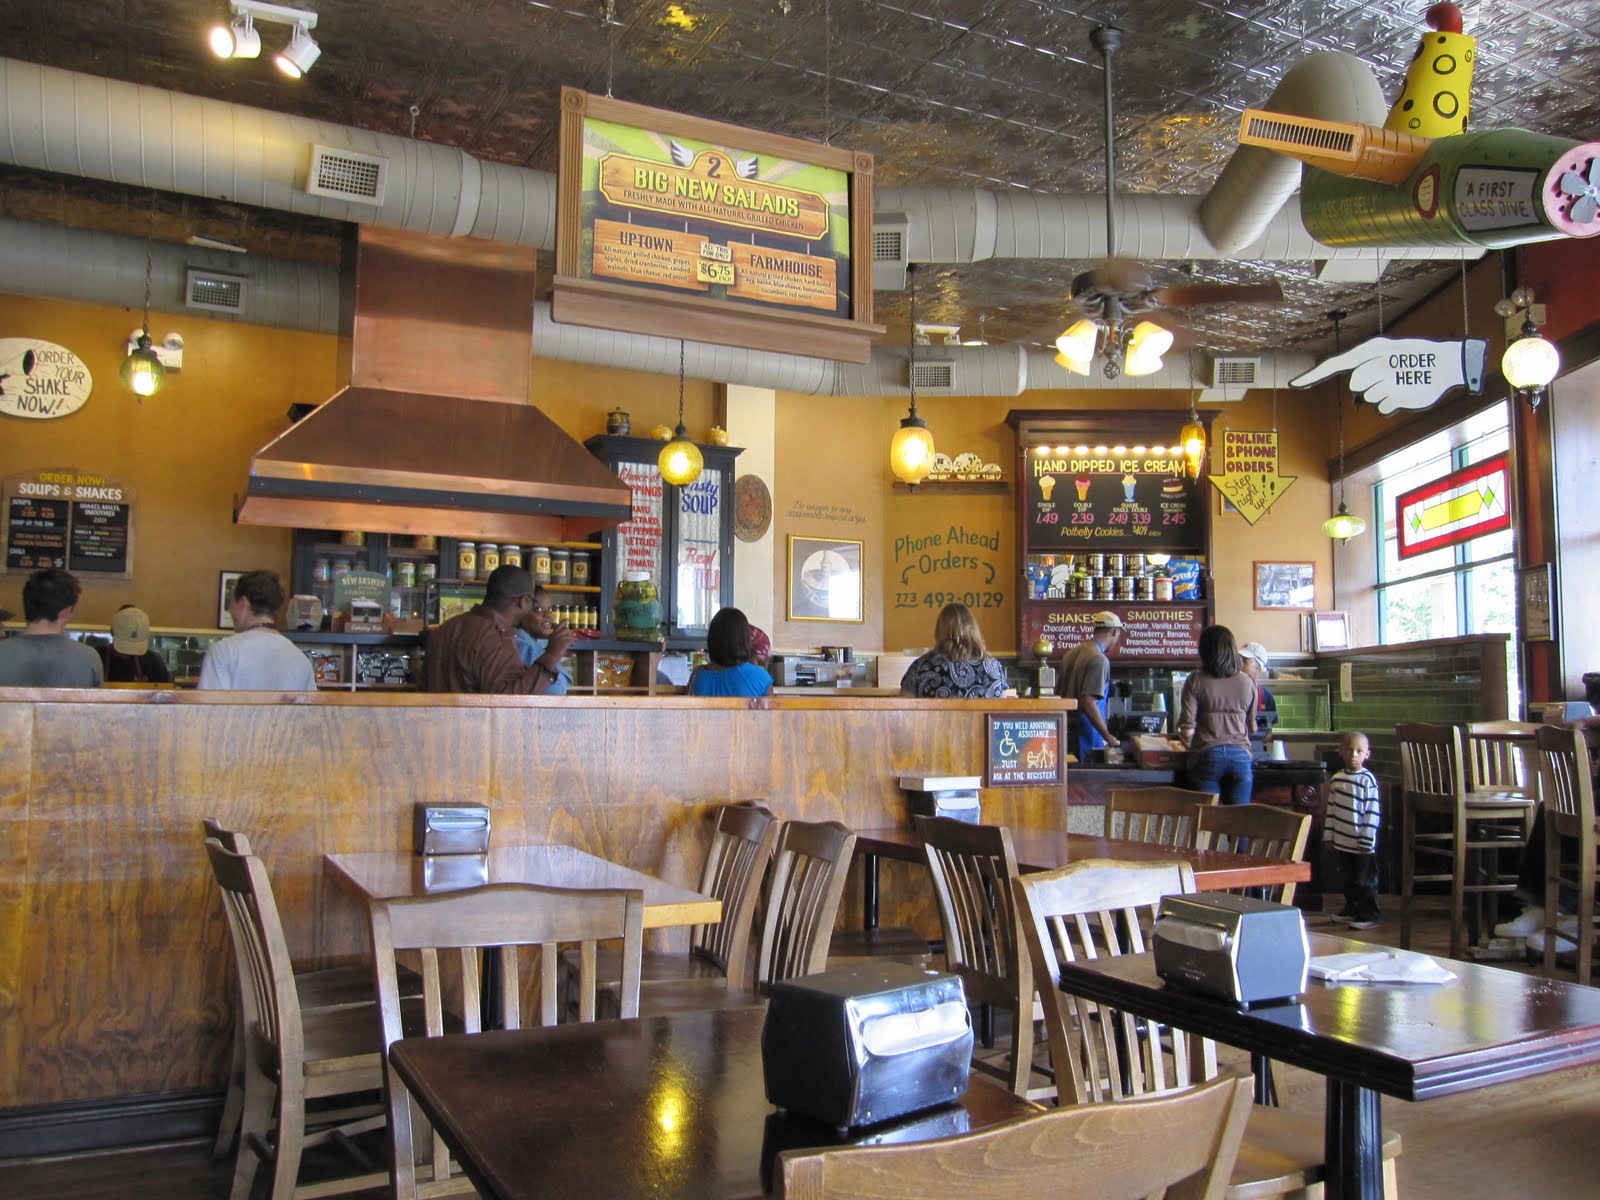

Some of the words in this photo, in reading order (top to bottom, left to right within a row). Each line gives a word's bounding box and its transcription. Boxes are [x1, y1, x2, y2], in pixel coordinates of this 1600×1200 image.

[708, 157, 721, 179] 2
[633, 167, 669, 193] BIG
[674, 175, 719, 203] NEW
[722, 185, 800, 218] SALADS
[1466, 182, 1475, 197] A
[1479, 181, 1515, 198] FIRST
[624, 190, 654, 203] FRESHLY
[655, 197, 677, 208] MADE
[678, 200, 700, 211] WITH
[746, 211, 774, 225] GRILLED
[775, 217, 804, 230] CHICKEN
[1459, 200, 1496, 218] CLASS
[1499, 200, 1529, 217] DIVE
[620, 231, 673, 253] UPTOWN
[704, 243, 714, 251] ALL
[716, 245, 729, 254] THIS
[612, 247, 633, 257] natural
[633, 250, 651, 259] grilled
[715, 252, 729, 260] ONLY
[624, 257, 638, 265] dried
[671, 264, 691, 273] candied
[630, 266, 643, 274] blue
[700, 262, 731, 278] $6.75
[750, 254, 823, 279] FARMHOUSE
[749, 270, 766, 278] natural
[767, 272, 784, 281] grilled
[804, 277, 815, 285] hard
[816, 280, 832, 288] boiled
[773, 280, 784, 288] blue
[37, 350, 75, 365] ORDER
[1389, 353, 1436, 369] ORDER
[55, 365, 85, 385] YOUR
[1396, 371, 1432, 385] HERE
[24, 377, 71, 396] SHAKE
[17, 395, 64, 415] NOW!
[1226, 432, 1273, 444] ONLINE
[1226, 445, 1235, 458] &
[1235, 445, 1276, 458] PHONE
[620, 467, 648, 482] Choice
[1034, 460, 1067, 477] HAND
[1070, 460, 1115, 473] DIPPED
[1120, 460, 1140, 473] ICE
[1143, 460, 1186, 478] CREAM
[1226, 461, 1274, 473] ORDERS
[40, 472, 73, 484] ORDER
[1224, 474, 1251, 497] Step
[19, 482, 60, 497] SOUPS
[64, 487, 72, 496] &
[76, 486, 122, 500] SHAKES
[630, 484, 662, 497] PPINGS
[685, 480, 720, 496] asty
[1237, 484, 1260, 508] right
[682, 493, 718, 515] SOUP
[1253, 491, 1268, 510] up!
[1036, 512, 1059, 524] 1.49
[1071, 513, 1095, 524] 2.39
[1162, 513, 1186, 525] 2.45
[618, 526, 631, 534] HOT
[1061, 526, 1093, 539] Potbelly
[894, 532, 942, 563] Phone
[946, 526, 1000, 552] Ahead
[687, 547, 717, 565] Real
[918, 550, 979, 575] Orders
[342, 576, 357, 586] NEW
[357, 576, 386, 588] ANSWER
[895, 591, 917, 603] 773
[923, 591, 1004, 609] 493-0129
[1127, 611, 1193, 621] SMOOTHIES
[993, 721, 1001, 729] IF
[1002, 721, 1014, 730] YOU
[1014, 721, 1029, 730] NEED
[1029, 721, 1057, 729] ADDITIONAL
[993, 772, 1003, 781] ASK
[1004, 772, 1011, 780] AT
[1013, 772, 1025, 780] THE
[1027, 770, 1057, 780] REGISTER!
